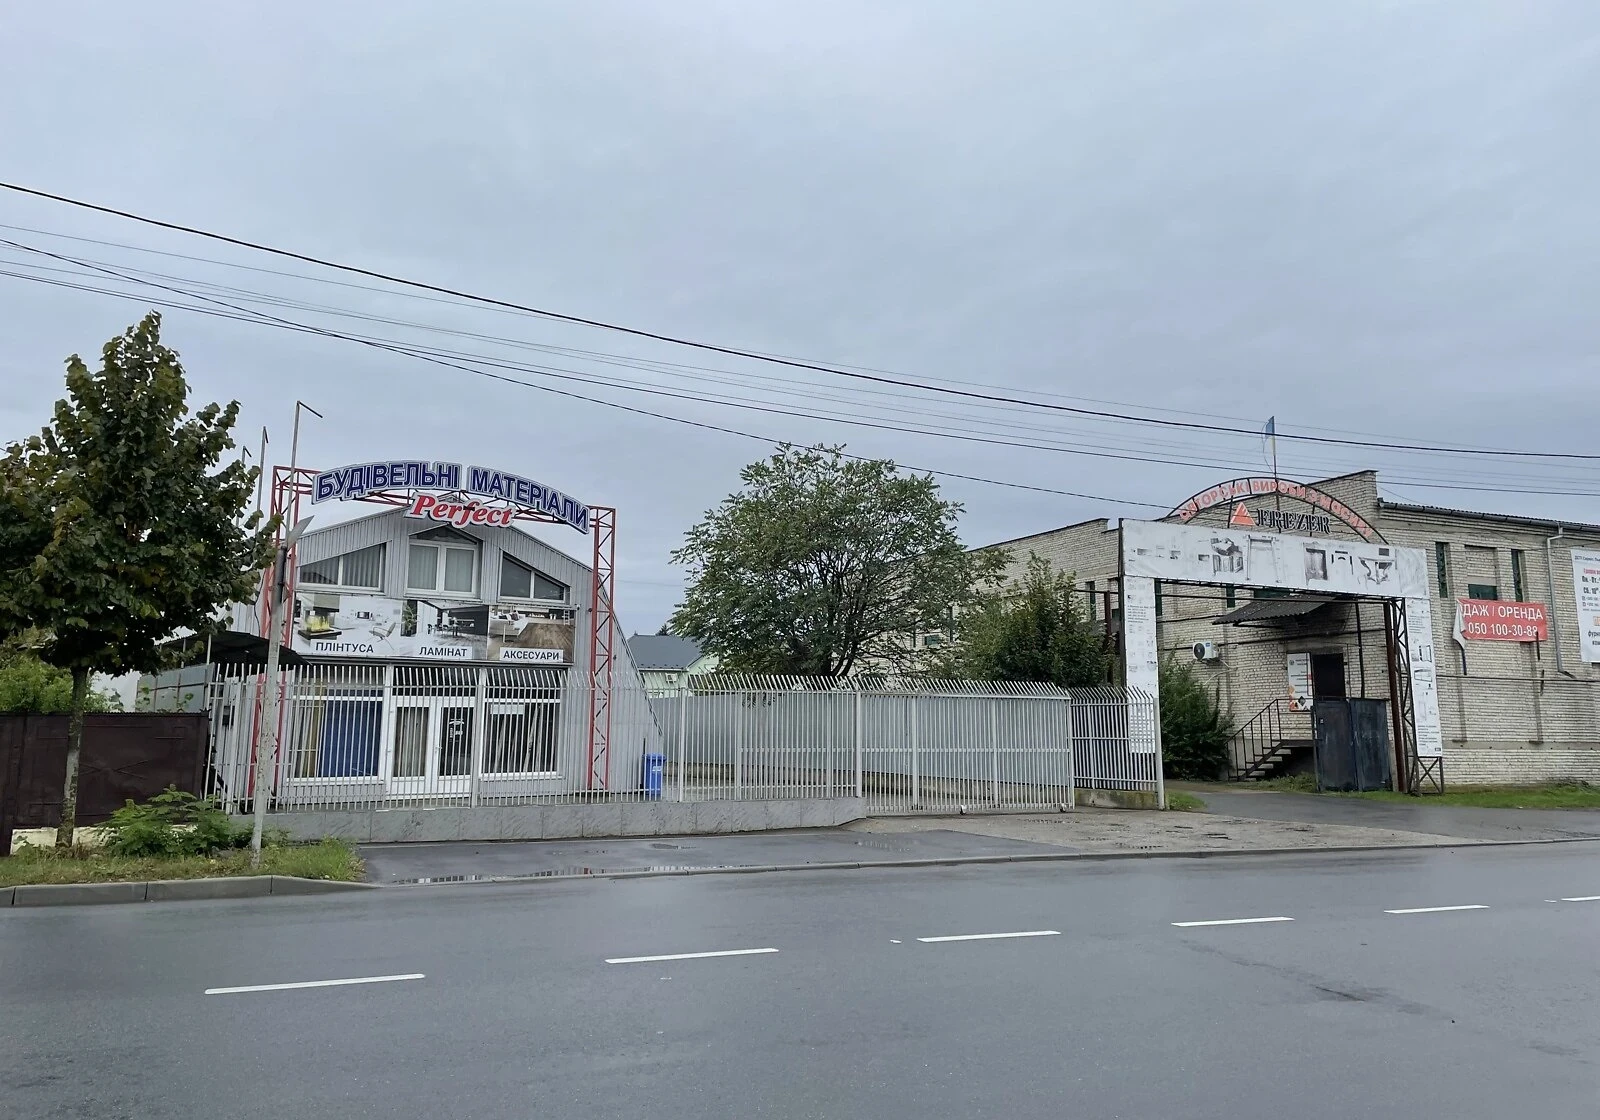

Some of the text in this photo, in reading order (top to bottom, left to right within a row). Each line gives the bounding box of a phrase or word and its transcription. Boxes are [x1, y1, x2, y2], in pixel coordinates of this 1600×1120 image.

[316, 462, 590, 533] БУДІВЕЛЬНІ МАТЕРІАЛИ
[1253, 480, 1307, 499] ВИРОБИ
[410, 494, 513, 527] Perfect
[1498, 605, 1544, 622] ОРЕНДА
[1468, 622, 1539, 637] 050 100-30-88
[315, 641, 374, 654] ПЛІНТУСА
[419, 646, 468, 658] ЛАМІНАТ
[503, 651, 560, 661] АКСЕСУАРИ
